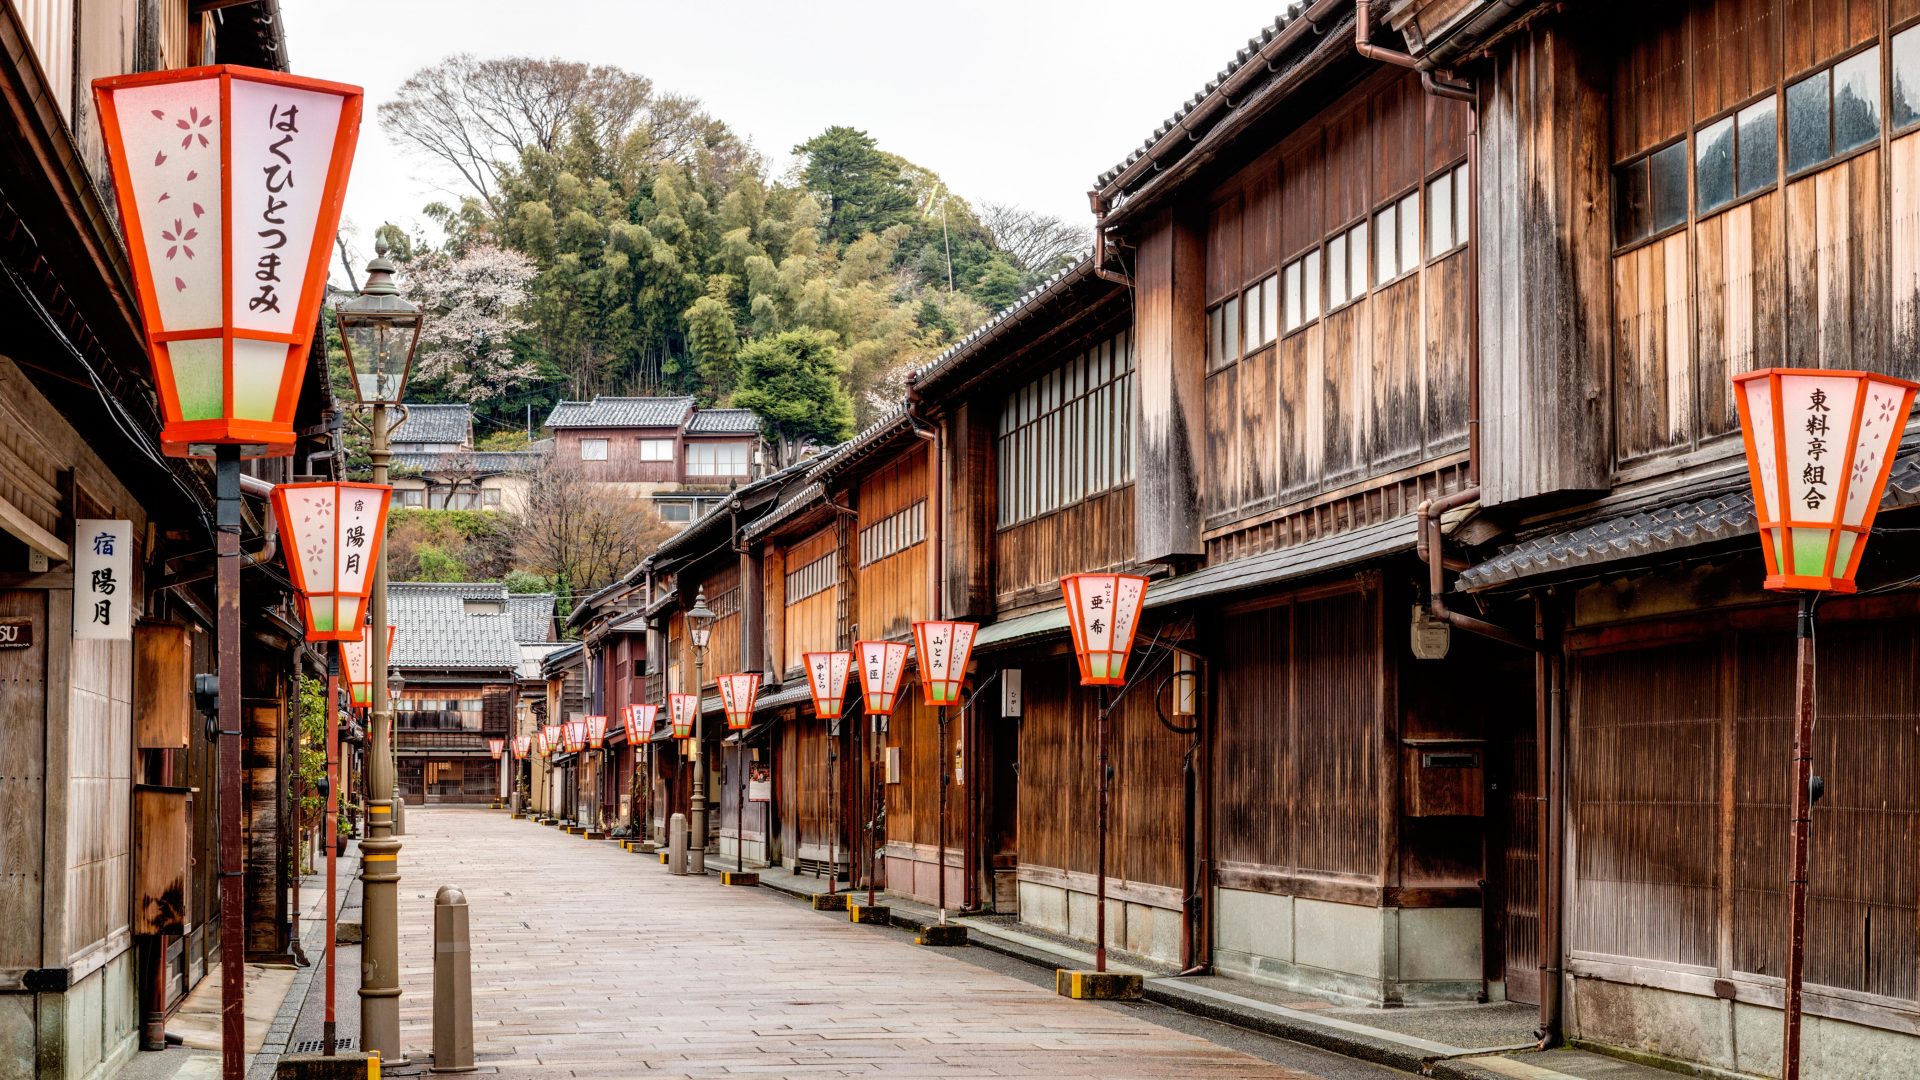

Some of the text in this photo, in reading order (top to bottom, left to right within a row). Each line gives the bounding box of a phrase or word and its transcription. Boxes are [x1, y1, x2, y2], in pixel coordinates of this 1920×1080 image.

[248, 103, 300, 314] はくひとつまみ
[1802, 387, 1831, 510] 東料亭組合
[1104, 582, 1112, 604] 山とみ
[1090, 594, 1106, 635] 亜希
[932, 636, 943, 668] 山とみ
[816, 662, 827, 690] 中むら
